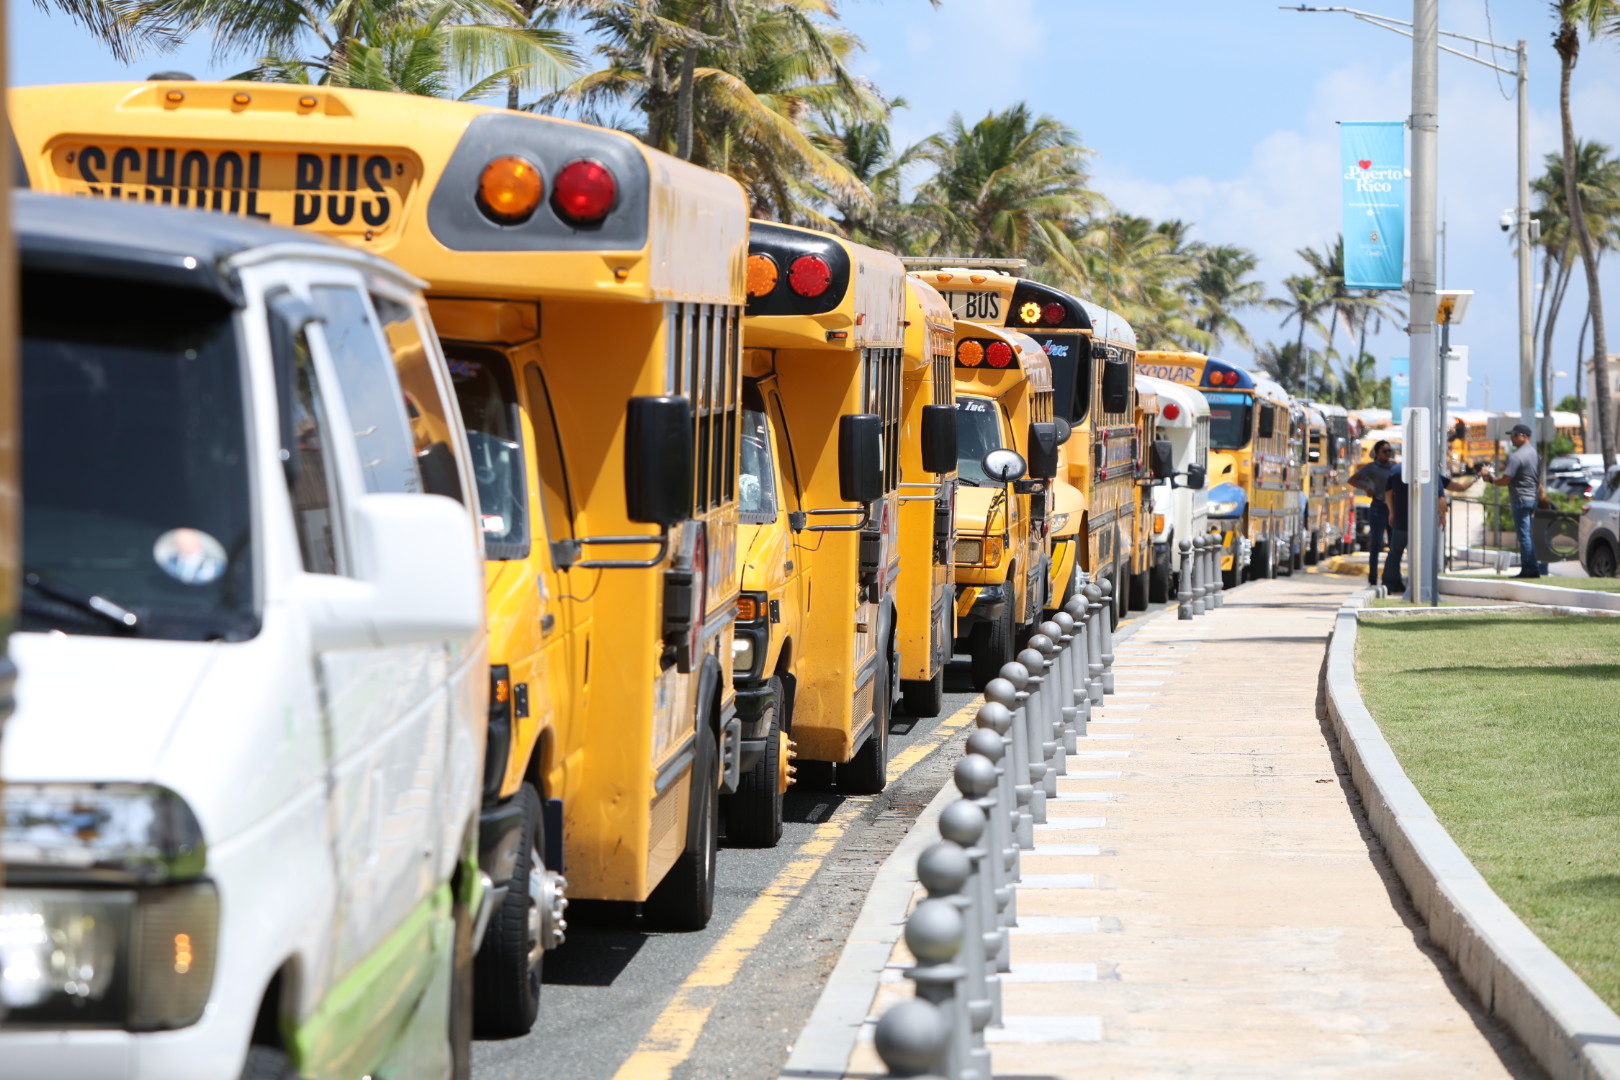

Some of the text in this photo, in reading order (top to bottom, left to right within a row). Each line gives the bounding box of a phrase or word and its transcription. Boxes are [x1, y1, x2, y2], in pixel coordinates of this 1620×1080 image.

[1344, 165, 1403, 180] Puerto
[77, 145, 392, 227] SCHOOL BUS
[1356, 179, 1392, 192] Rico
[966, 291, 999, 319] BUS
[964, 401, 986, 413] Inc.
